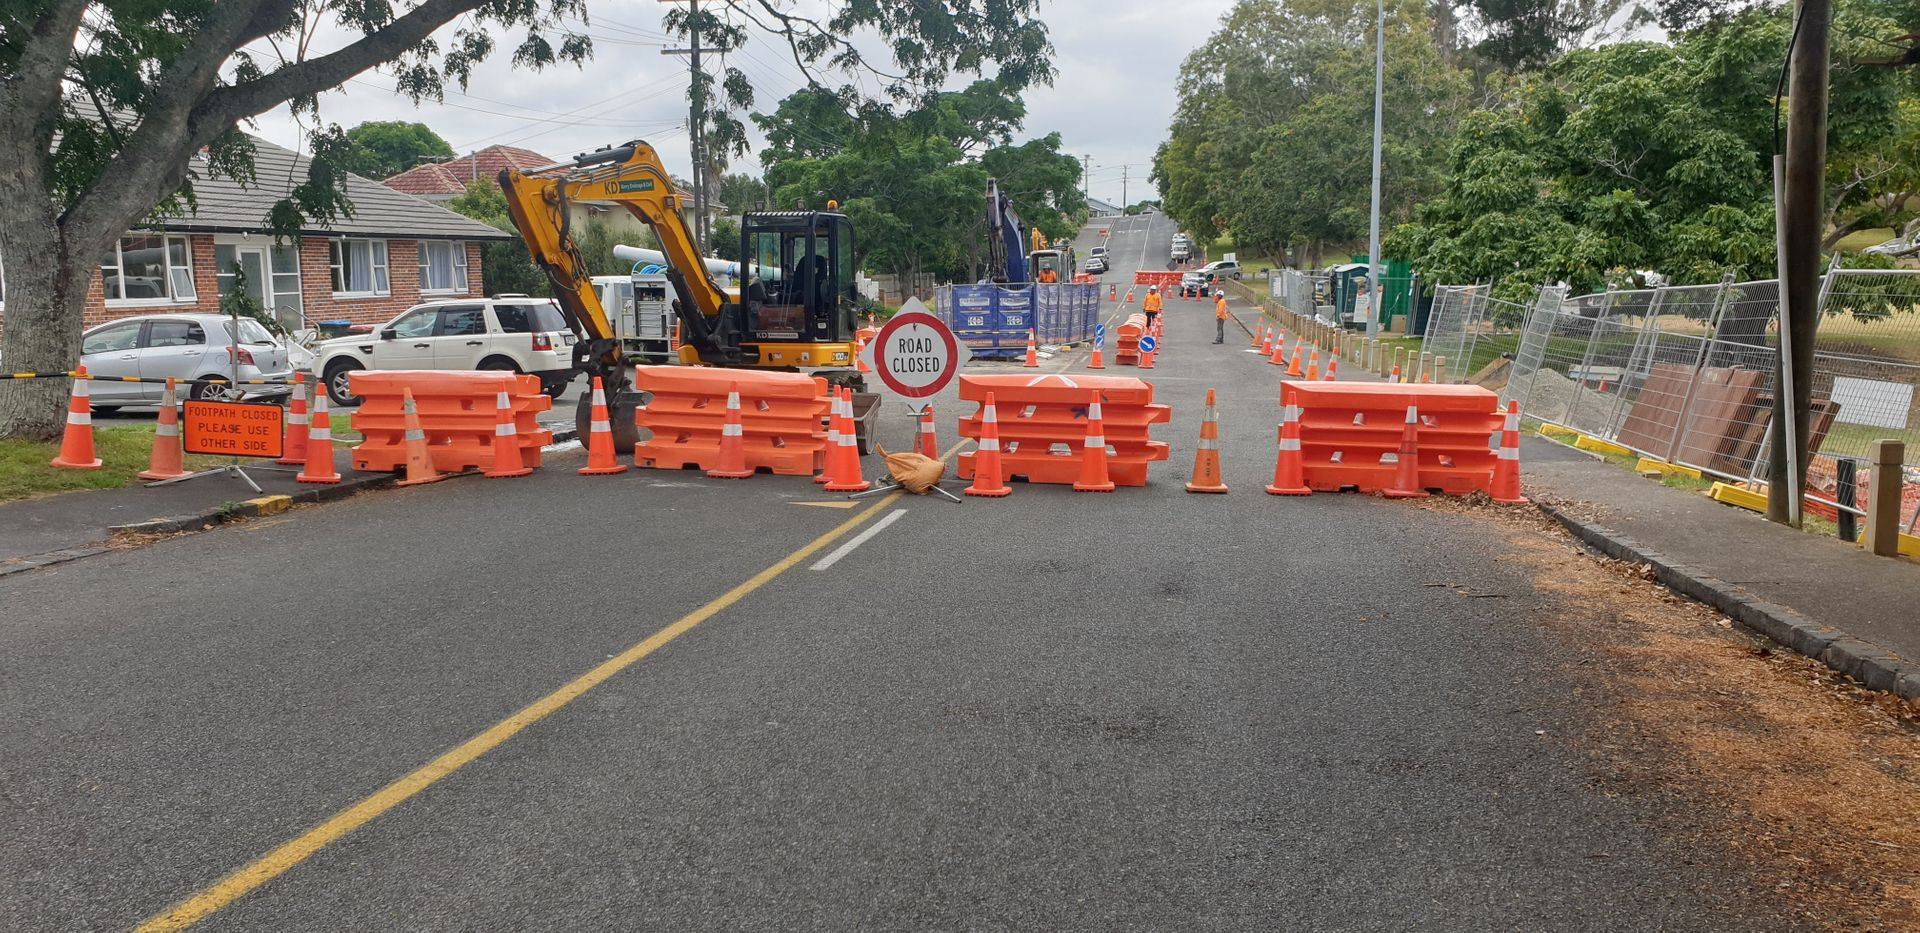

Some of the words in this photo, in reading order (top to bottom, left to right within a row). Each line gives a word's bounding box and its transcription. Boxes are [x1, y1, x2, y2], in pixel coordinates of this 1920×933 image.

[605, 181, 618, 195] KD
[899, 338, 932, 353] ROAD
[893, 357, 939, 373] CLOSED
[189, 406, 236, 418] FOOTPATH
[242, 409, 278, 421] CLOSED
[198, 422, 242, 434] PLEASE
[248, 426, 269, 435] USE
[200, 438, 236, 448] OTHER
[244, 440, 268, 451] SIDE
